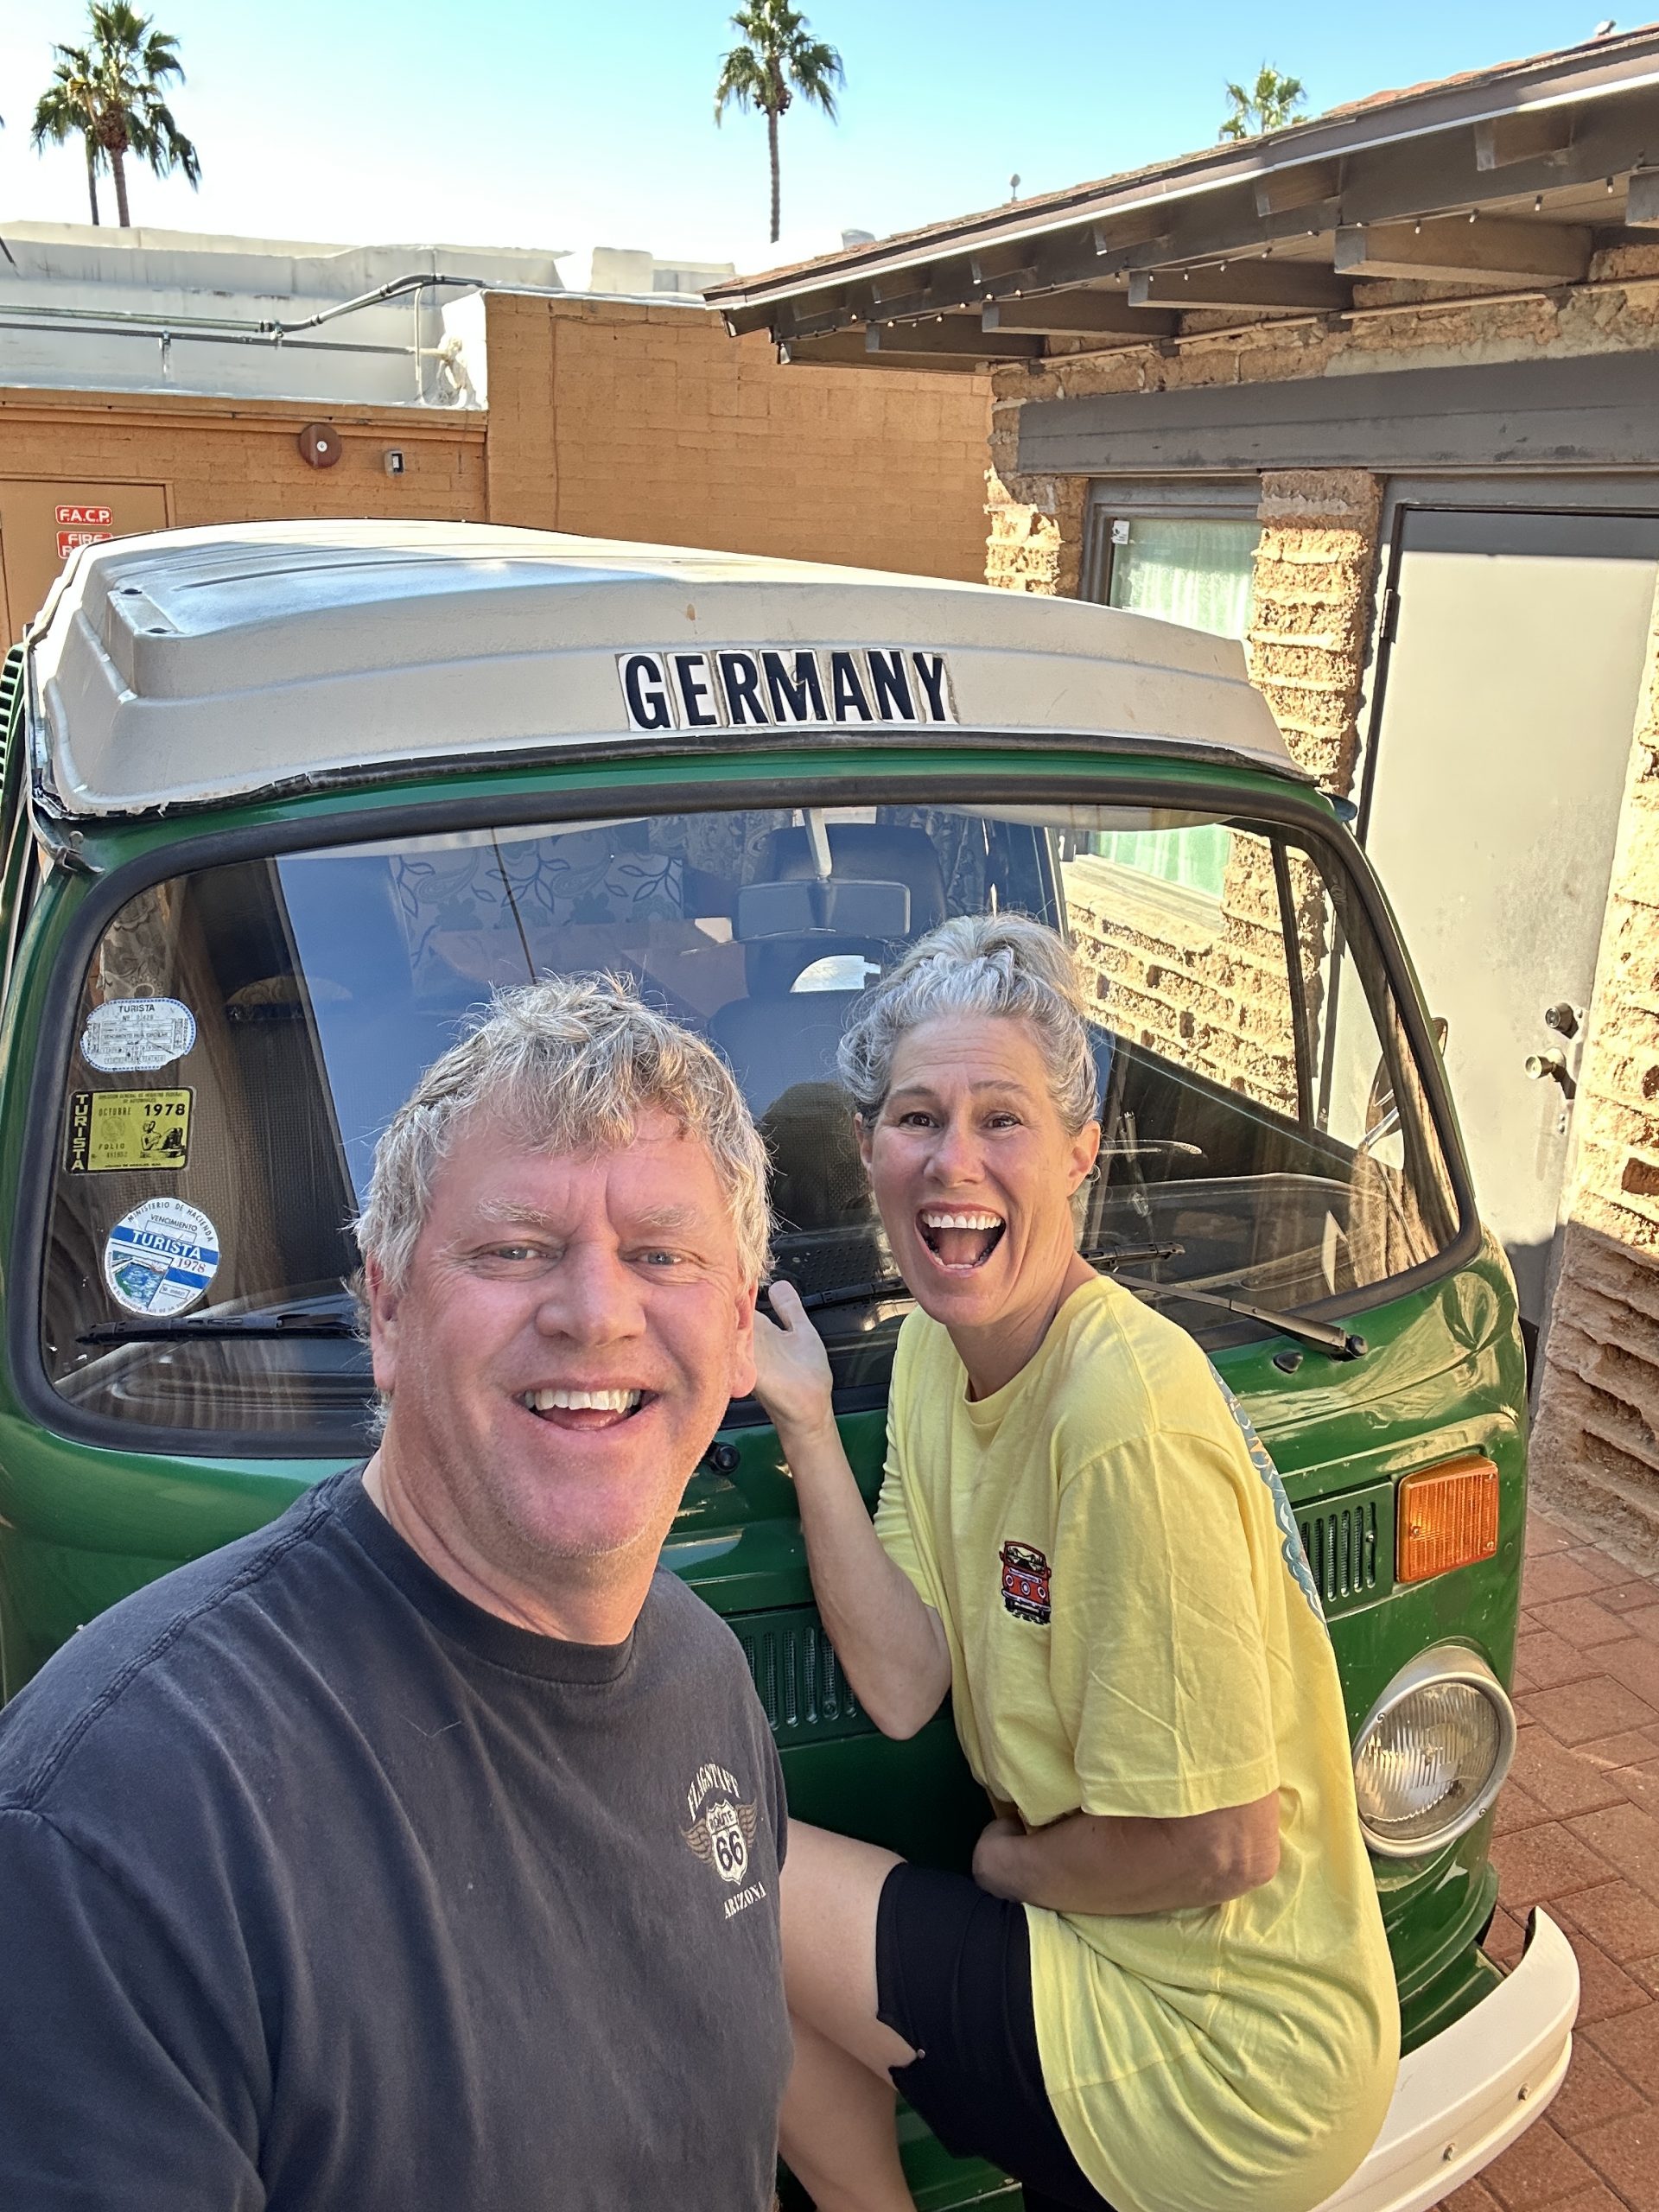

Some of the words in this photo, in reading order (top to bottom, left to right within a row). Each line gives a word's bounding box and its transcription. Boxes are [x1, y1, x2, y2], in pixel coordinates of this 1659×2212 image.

[625, 650, 945, 729] GERMANY
[118, 1004, 156, 1013] TURISTA
[99, 1107, 131, 1116] OCTUBRE
[144, 1103, 185, 1116] 1978
[71, 1094, 89, 1170] TURISTA
[128, 1201, 170, 1222] MINISTERIO
[175, 1203, 185, 1211] DE
[187, 1209, 214, 1242] HACIENDA
[150, 1213, 198, 1232] VENCIMIENTO
[132, 1230, 201, 1260] TURISTA
[177, 1258, 206, 1274] 1978
[709, 1810, 734, 1828] ROUTE
[716, 1830, 744, 1872] 66
[724, 1880, 766, 1919] ARIZONA
